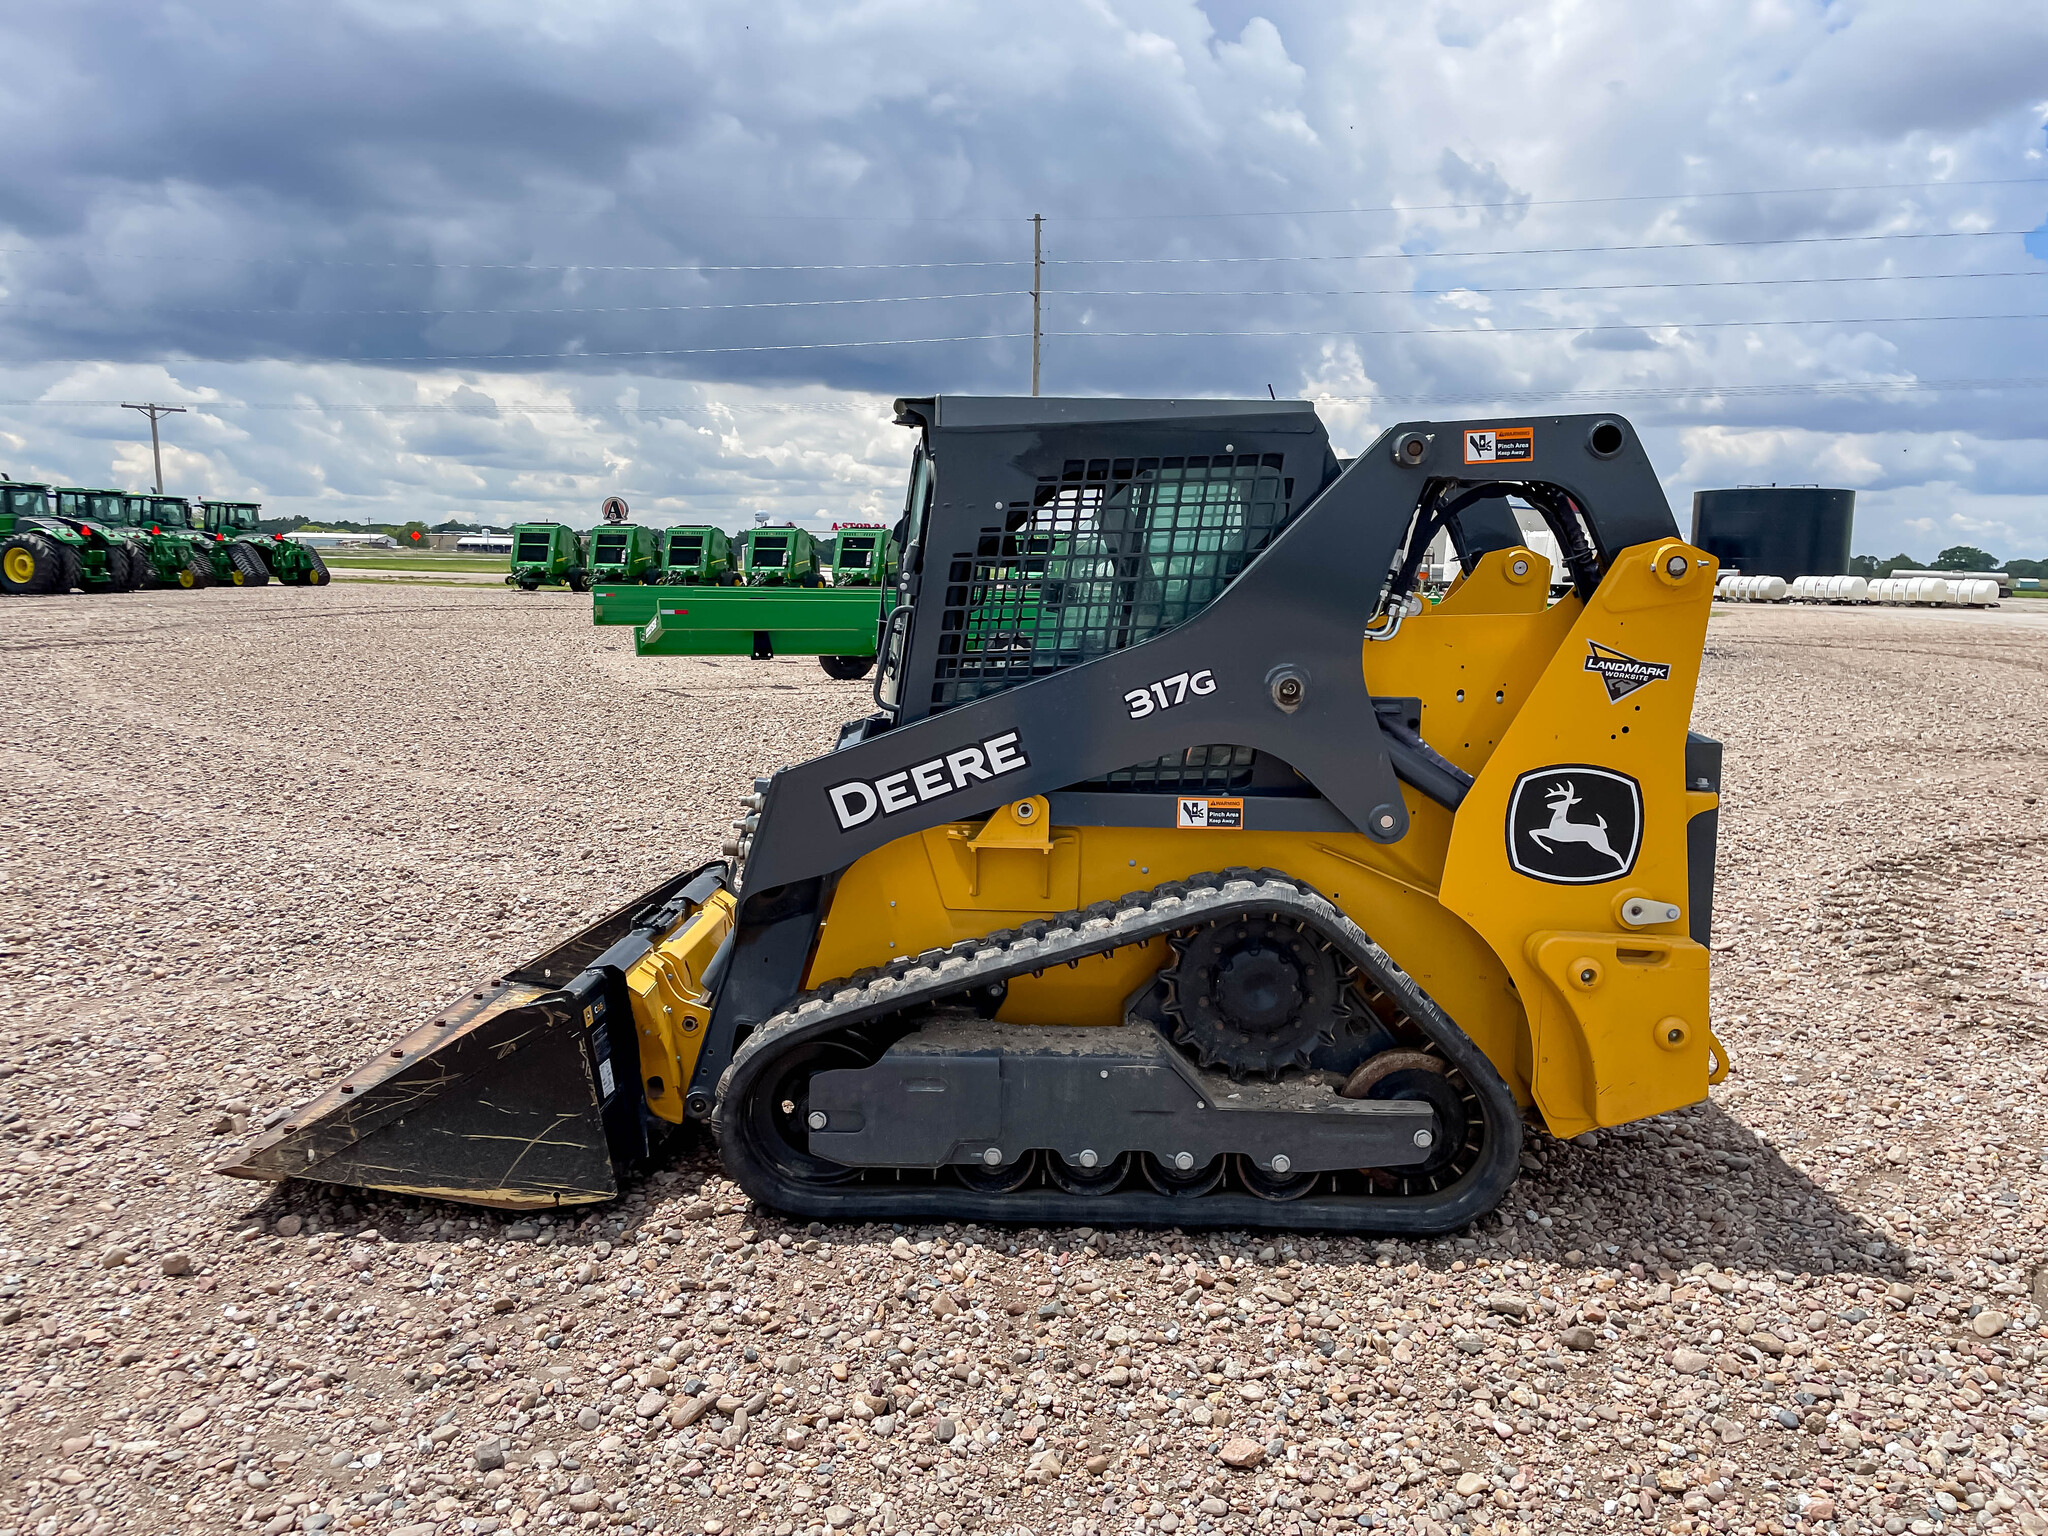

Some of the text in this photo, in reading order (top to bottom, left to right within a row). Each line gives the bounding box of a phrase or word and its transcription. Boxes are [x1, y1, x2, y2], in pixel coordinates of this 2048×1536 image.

[1587, 658, 1667, 677] LANDMARK
[1605, 671, 1649, 682] WORKSITE
[1124, 669, 1217, 719] 317G
[828, 732, 1026, 829] DEERE
